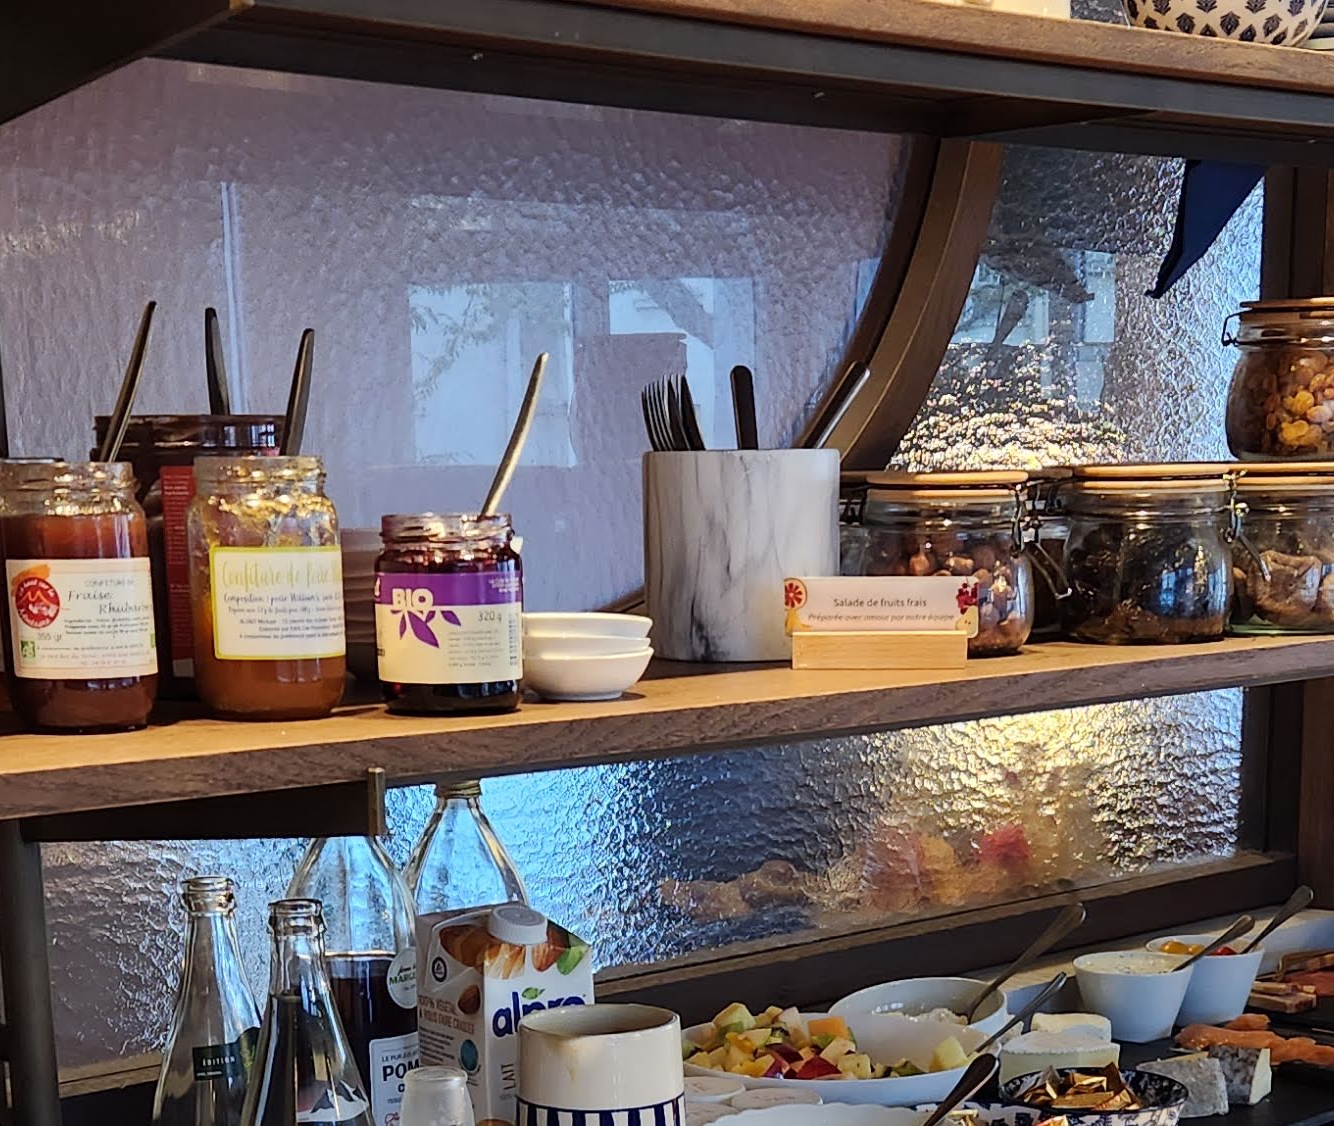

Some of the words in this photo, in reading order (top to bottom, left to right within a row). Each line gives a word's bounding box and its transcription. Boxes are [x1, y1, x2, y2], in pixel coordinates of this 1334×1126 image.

[222, 560, 280, 592] Confiture
[68, 590, 112, 602] Fraise
[392, 588, 434, 609] BIO
[833, 598, 865, 607] Salade
[867, 598, 878, 607] de
[880, 598, 905, 607] fruits
[906, 598, 927, 607] frais
[478, 610, 495, 622] 320
[891, 615, 904, 623] par
[382, 1057, 419, 1082] POM
[500, 1063, 516, 1090] LAIT
